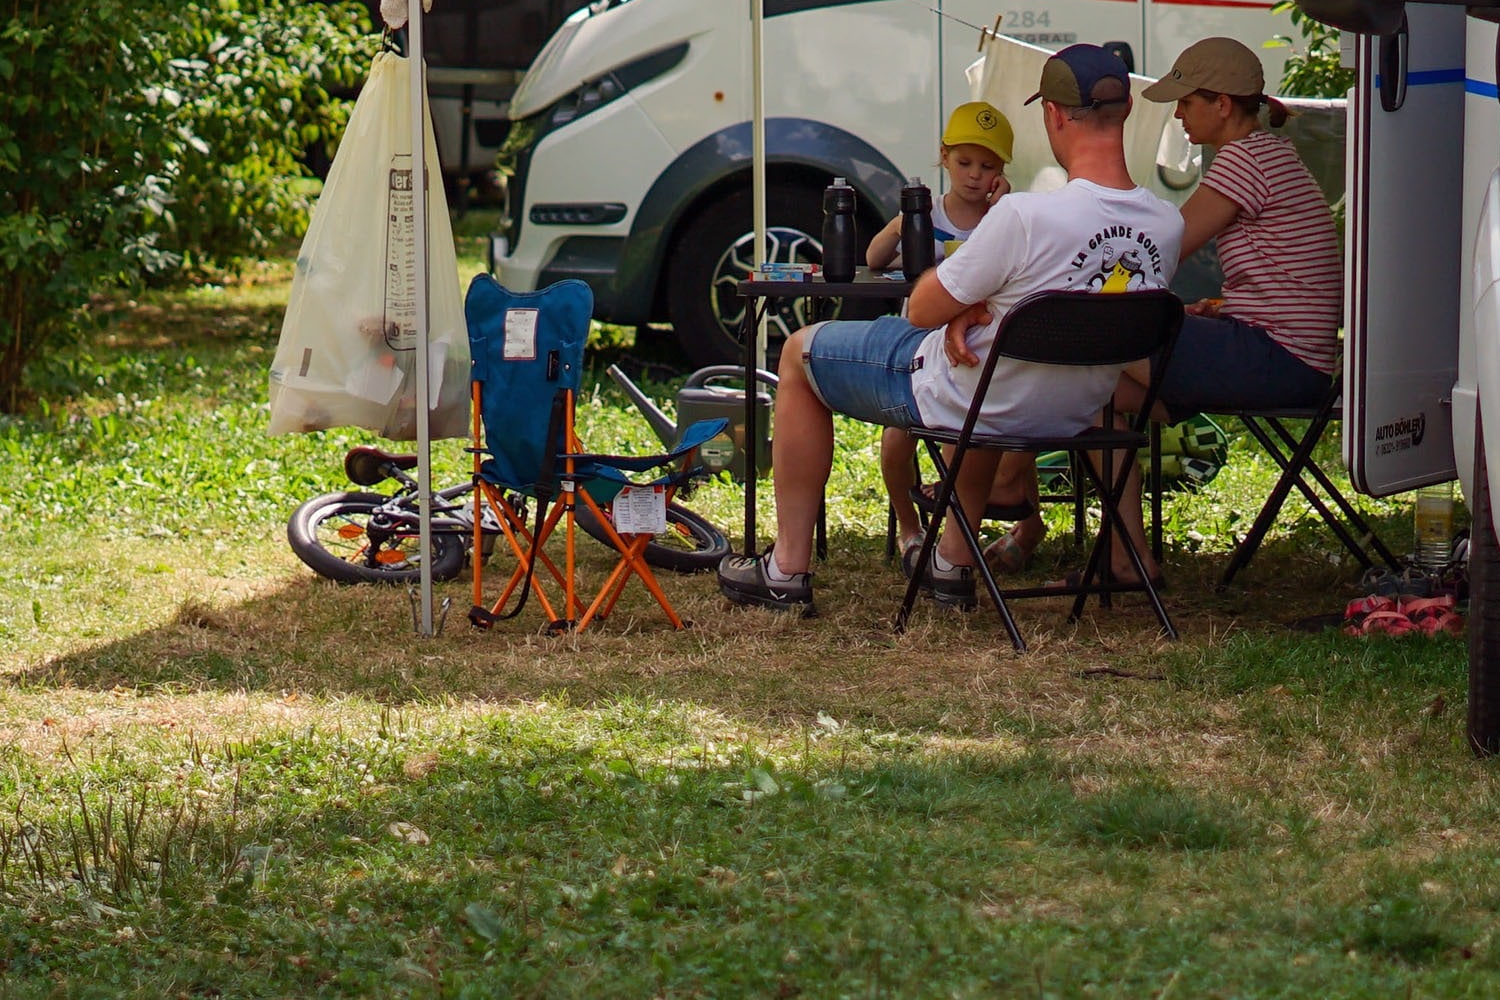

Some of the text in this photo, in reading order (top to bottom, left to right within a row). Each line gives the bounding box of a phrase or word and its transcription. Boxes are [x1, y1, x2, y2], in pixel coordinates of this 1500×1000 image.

[1006, 10, 1050, 28] 284
[1071, 225, 1162, 276] LA GRANDE BOUCLE
[1375, 417, 1421, 441] AUTO BÖHLER
